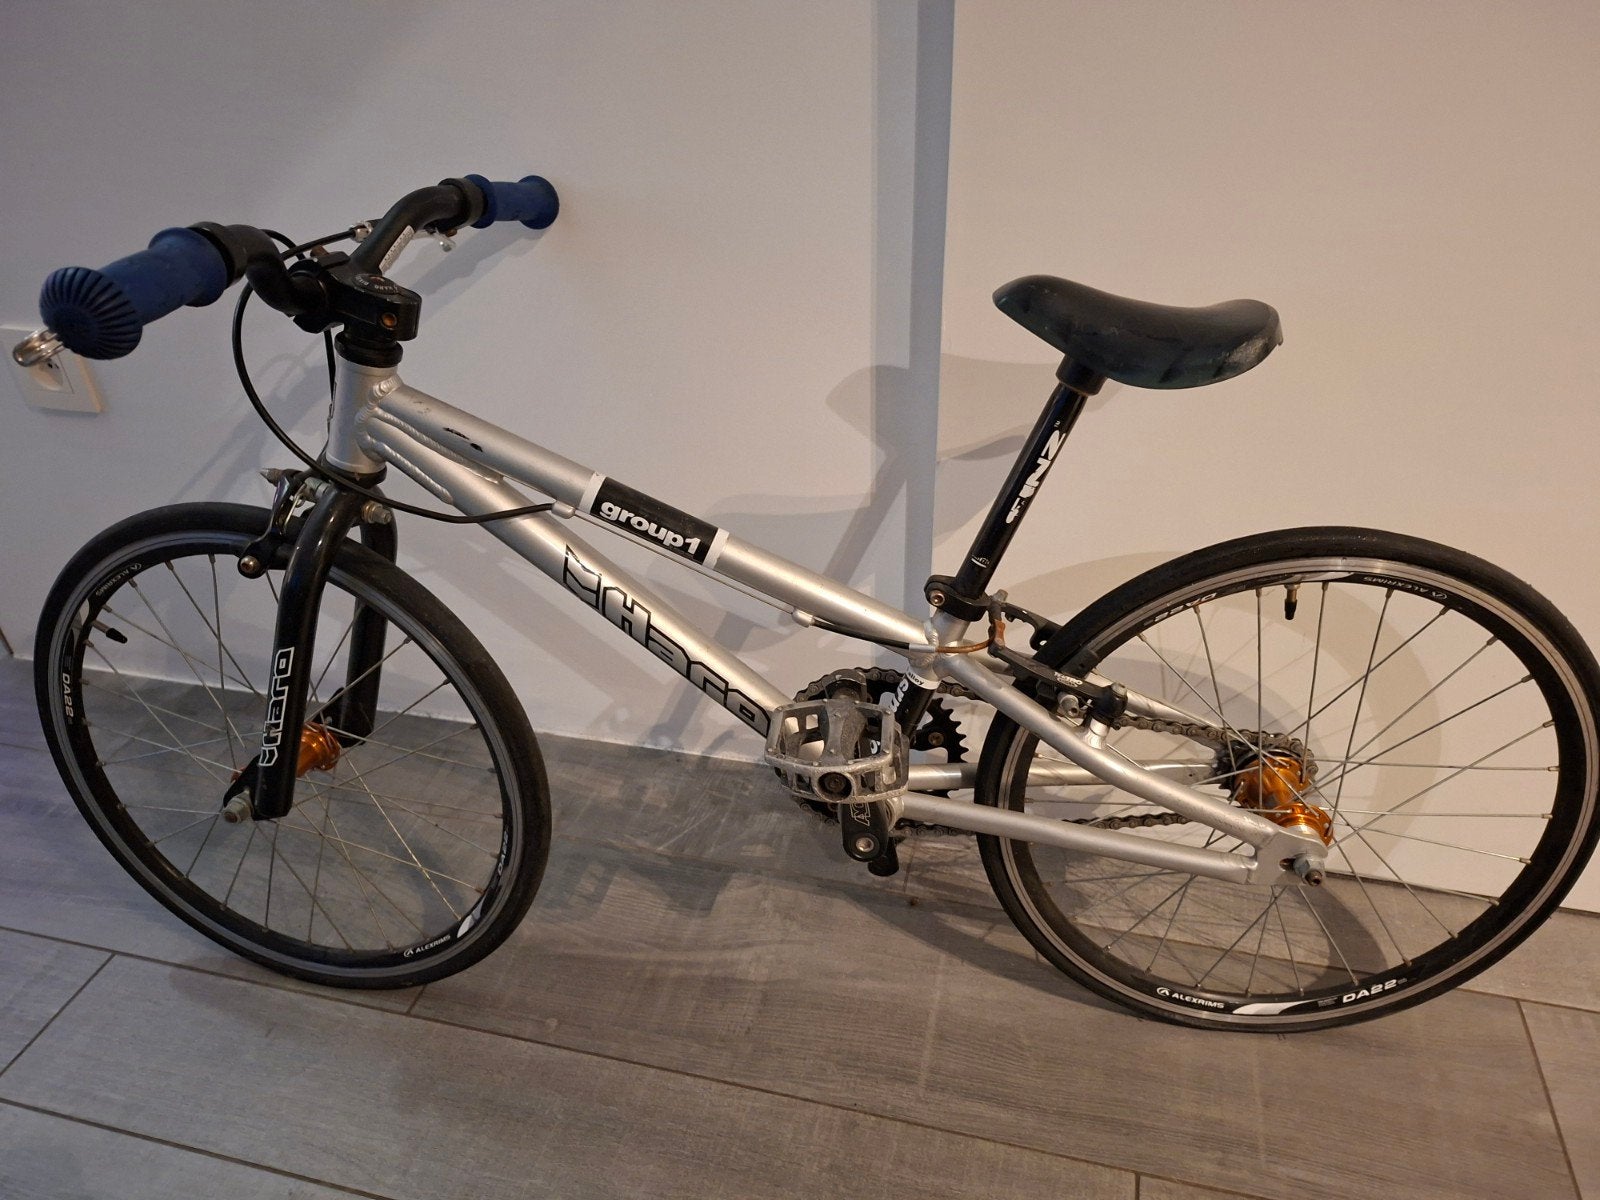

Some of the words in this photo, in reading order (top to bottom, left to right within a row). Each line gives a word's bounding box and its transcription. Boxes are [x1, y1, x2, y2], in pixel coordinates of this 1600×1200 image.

[600, 501, 701, 555] group1
[601, 586, 772, 739] Haro
[62, 672, 74, 718] DA22
[263, 646, 295, 747] Haro
[415, 934, 451, 954] ALEXRIMS
[1171, 992, 1225, 1010] ALEXRIMS
[1342, 979, 1397, 1004] DA22
